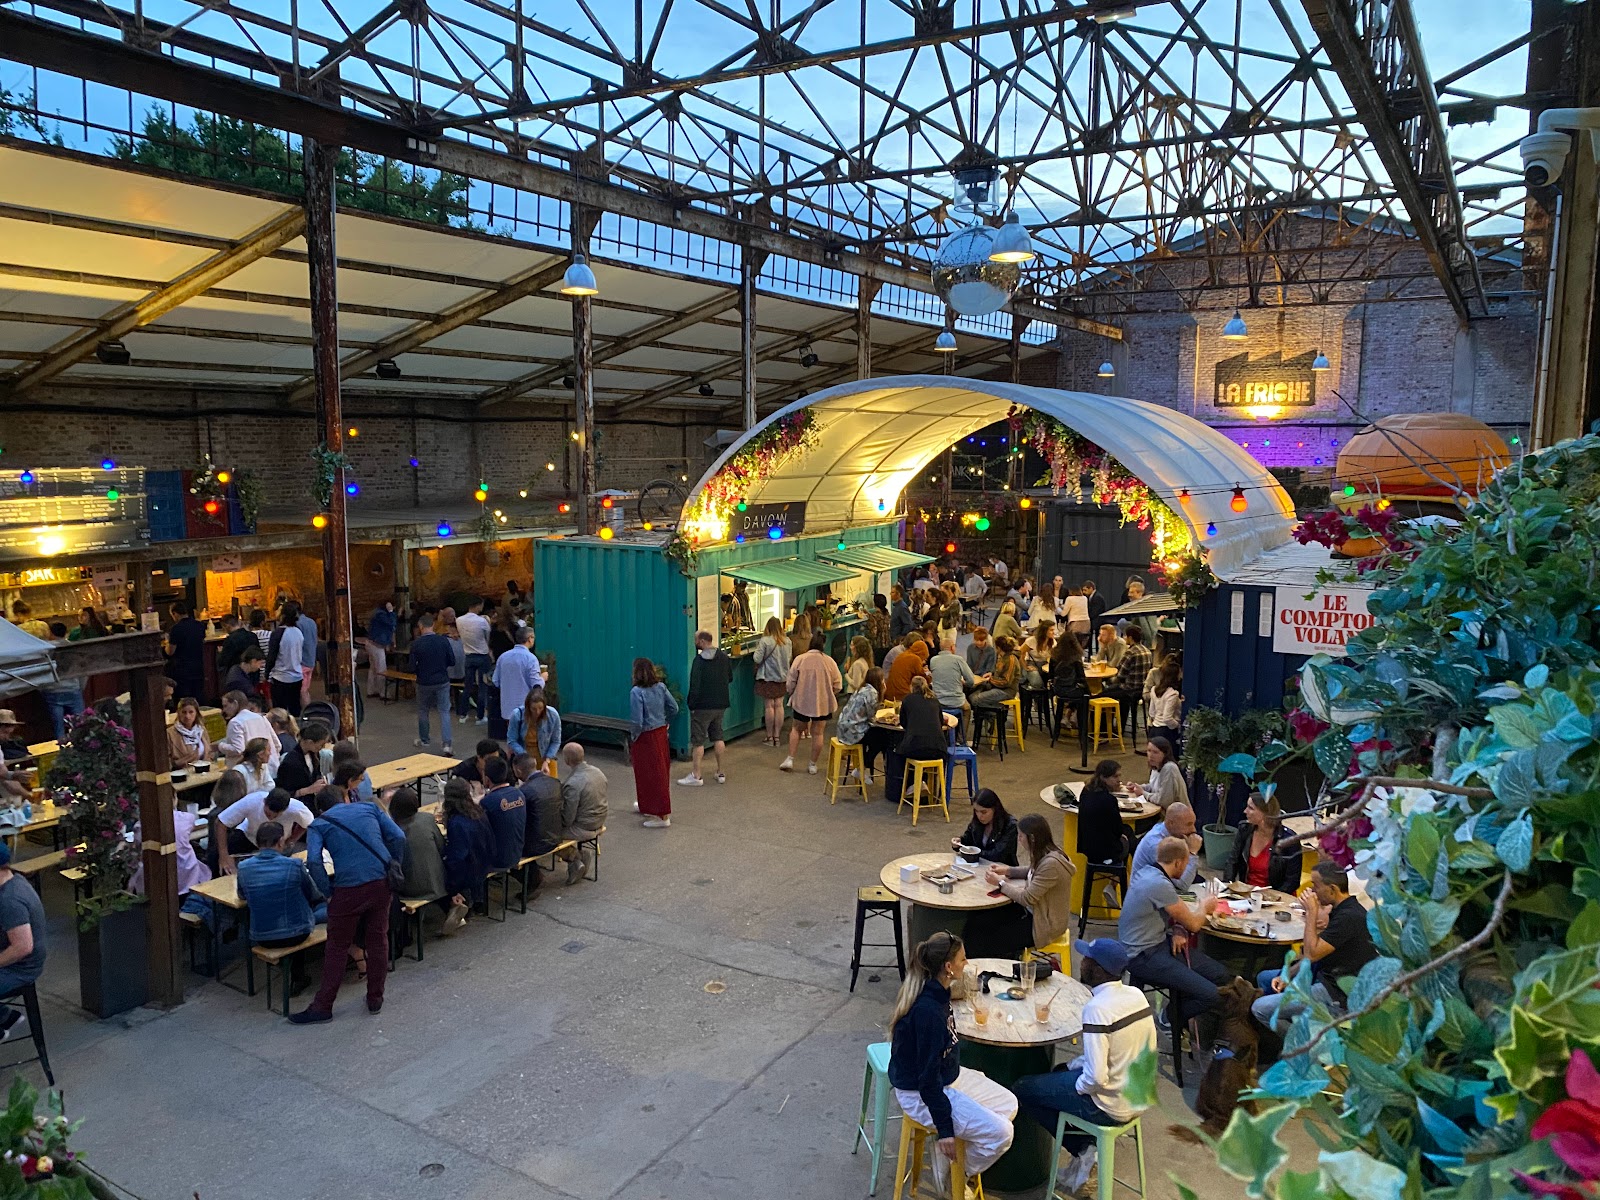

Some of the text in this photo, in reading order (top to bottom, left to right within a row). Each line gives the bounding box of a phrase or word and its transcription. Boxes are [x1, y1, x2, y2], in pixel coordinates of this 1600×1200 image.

[1218, 381, 1310, 403] LA FRICHE
[1323, 594, 1347, 612] LE
[1280, 608, 1375, 629] COMPTOI
[1294, 626, 1360, 646] VOLA
